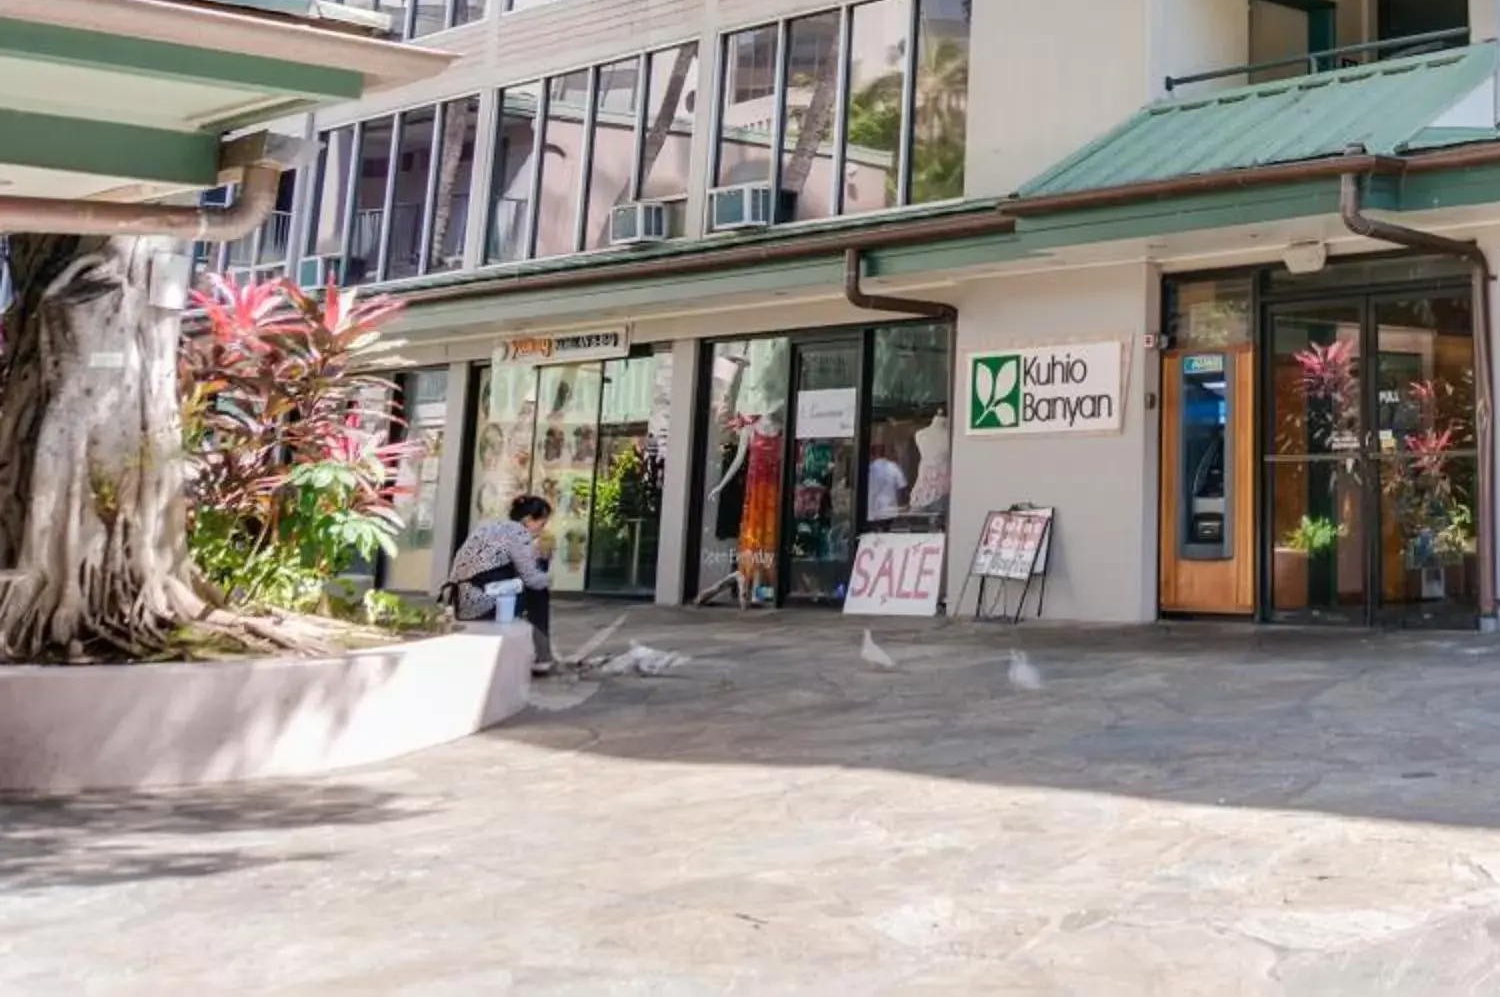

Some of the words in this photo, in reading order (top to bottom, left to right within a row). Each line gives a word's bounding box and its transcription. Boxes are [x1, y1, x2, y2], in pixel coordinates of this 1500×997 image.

[1023, 352, 1088, 386] Kuhio
[1023, 392, 1113, 428] Banyan
[851, 546, 940, 600] SALE
